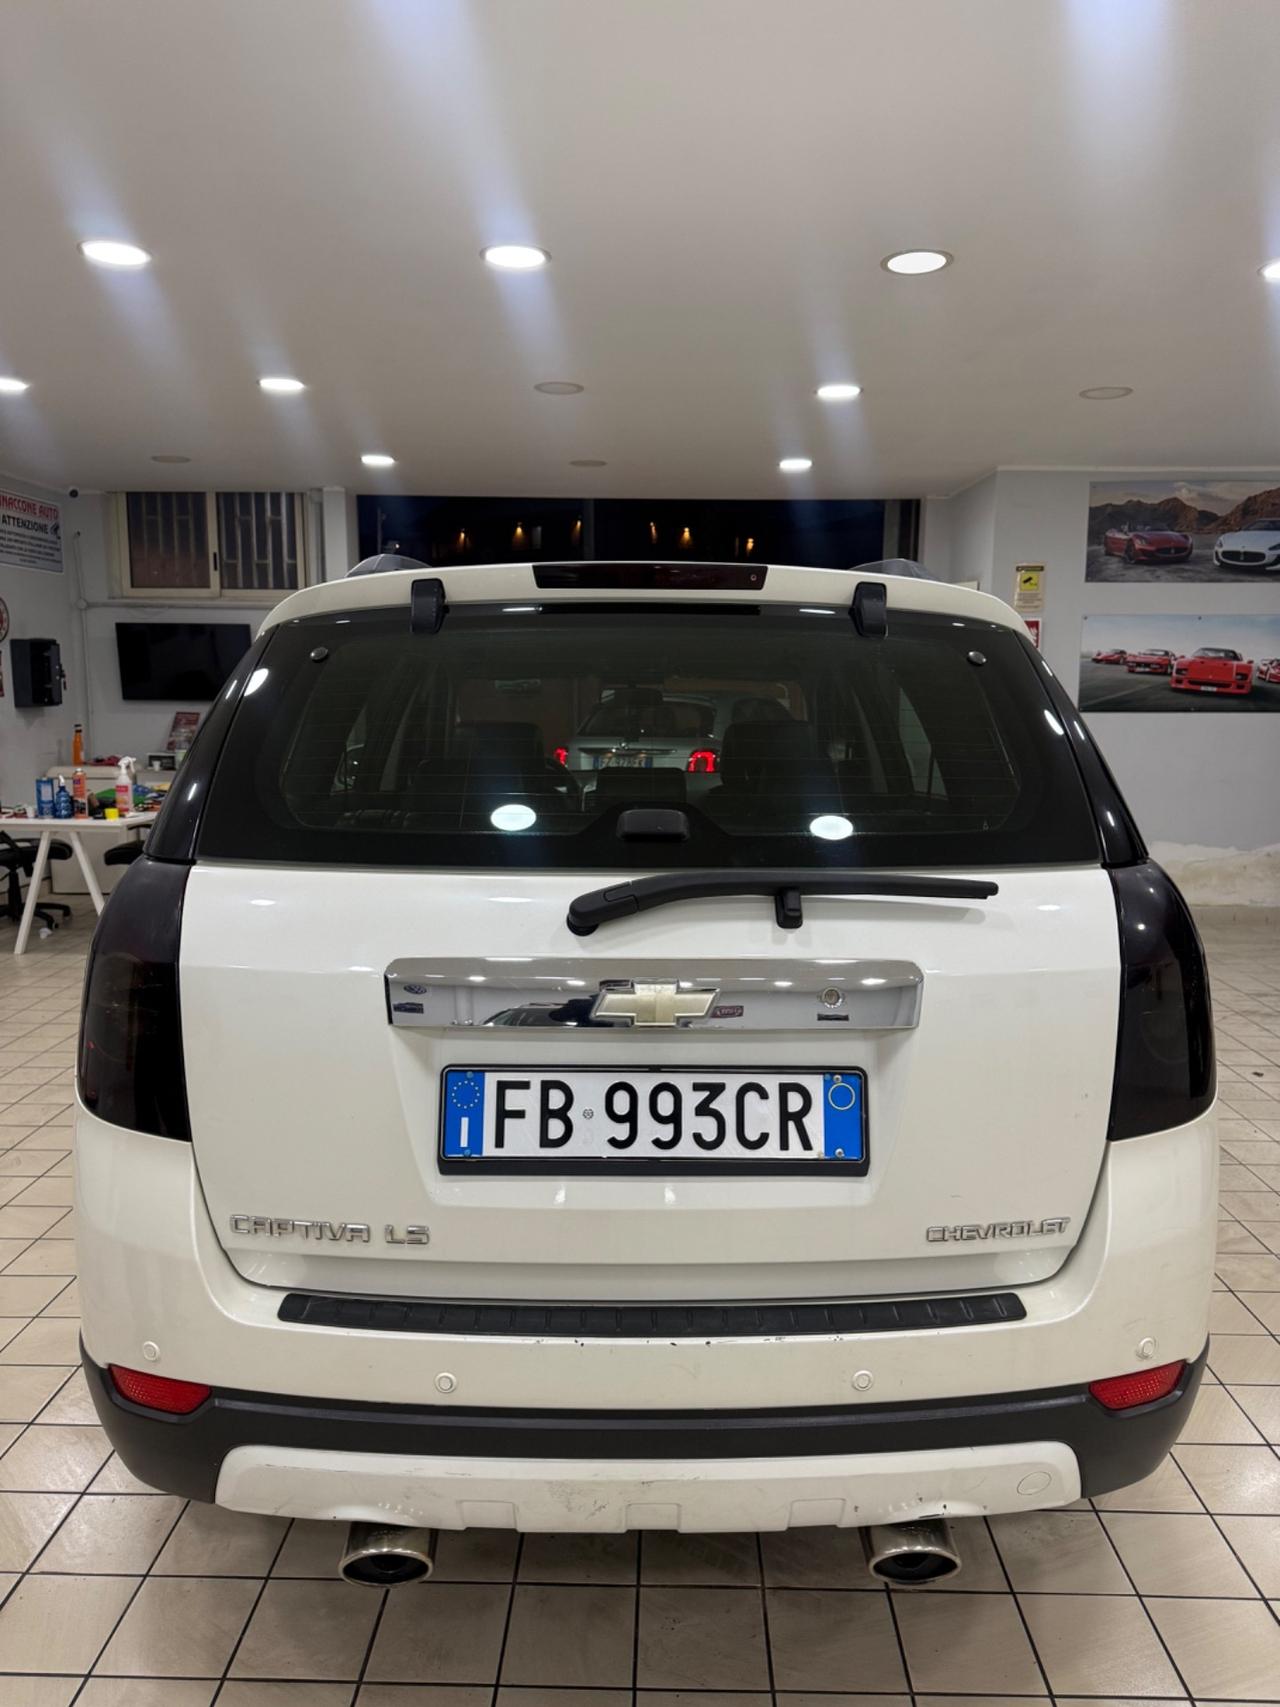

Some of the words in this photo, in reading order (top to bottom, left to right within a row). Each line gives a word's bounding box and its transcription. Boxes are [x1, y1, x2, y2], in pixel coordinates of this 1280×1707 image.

[0, 494, 37, 516] NACCONE
[38, 504, 59, 521] AUTO
[1, 514, 49, 534] ATTENZIONE
[495, 1080, 574, 1149] FB
[604, 1081, 813, 1151] 993CR
[230, 1214, 370, 1243] CAPTIVA
[384, 1224, 429, 1245] LS
[927, 1216, 1071, 1242] CHEVROLET
